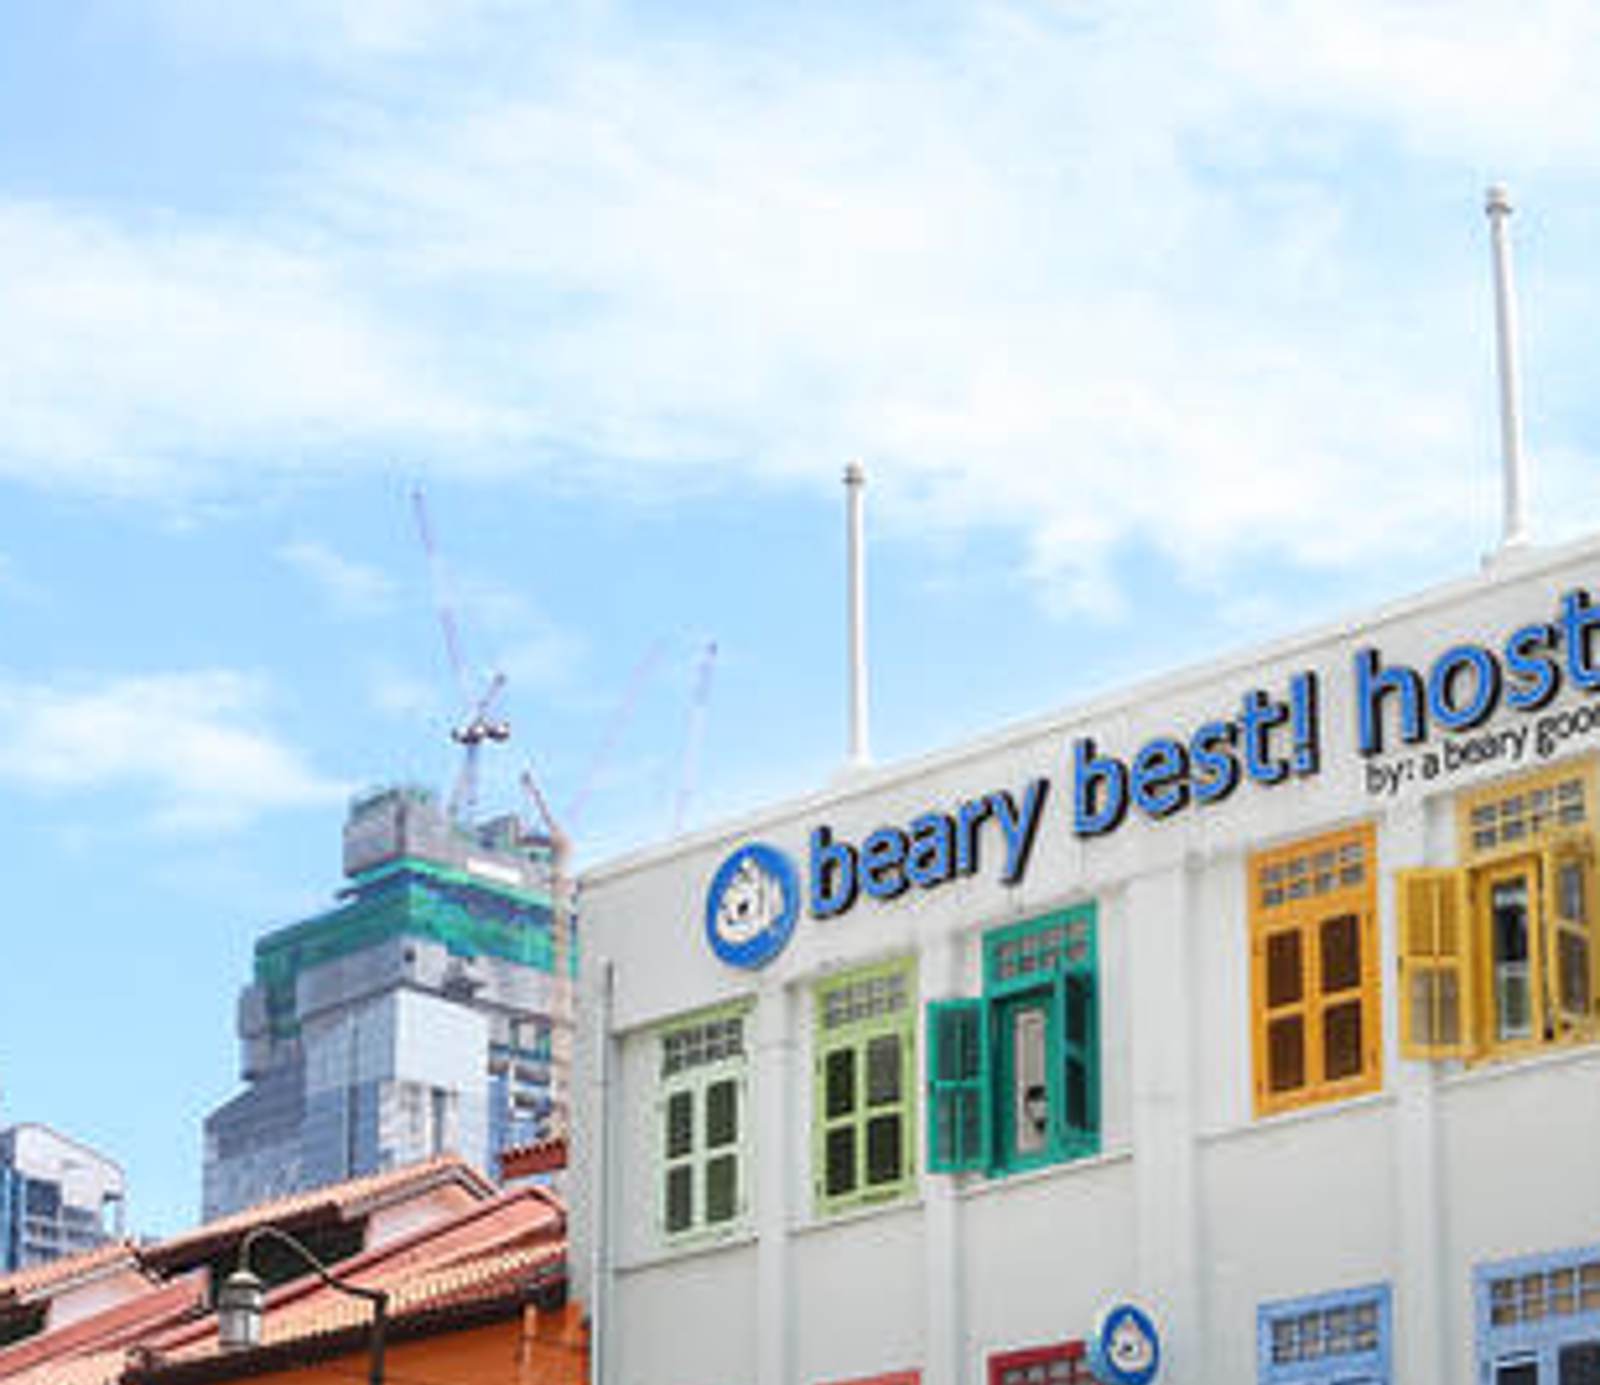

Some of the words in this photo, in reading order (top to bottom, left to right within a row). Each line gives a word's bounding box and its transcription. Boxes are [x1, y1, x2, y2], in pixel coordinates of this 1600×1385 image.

[809, 778, 1050, 920] beary
[1071, 670, 1320, 840] best!
[1355, 587, 1600, 757] host
[1365, 757, 1415, 796] by:
[1421, 752, 1440, 780] a
[1443, 725, 1529, 771] beary
